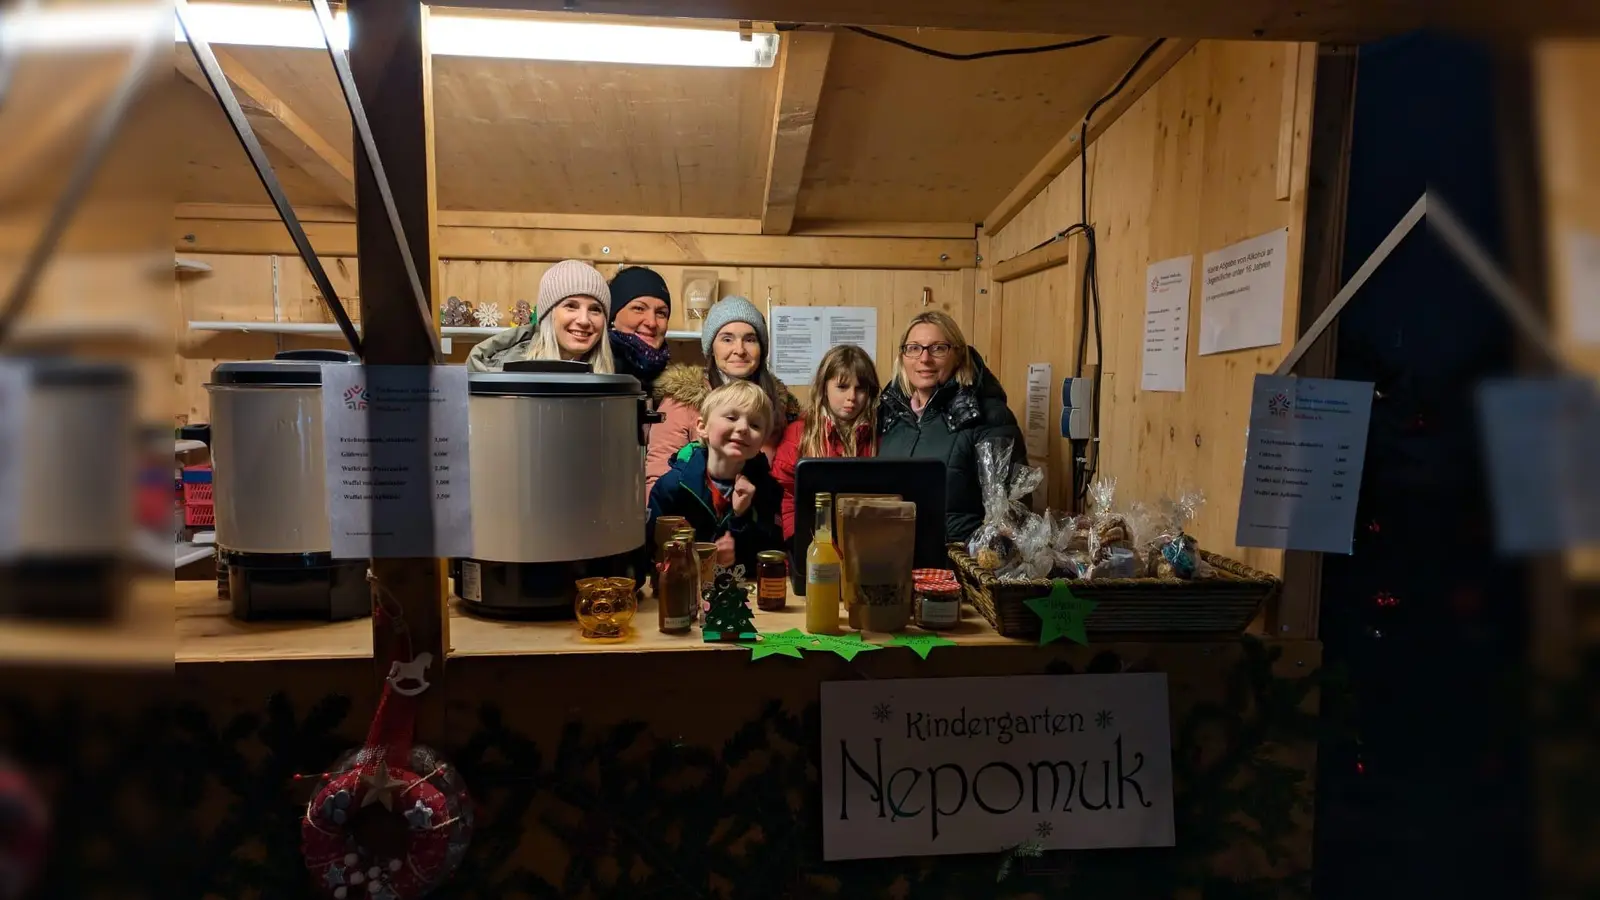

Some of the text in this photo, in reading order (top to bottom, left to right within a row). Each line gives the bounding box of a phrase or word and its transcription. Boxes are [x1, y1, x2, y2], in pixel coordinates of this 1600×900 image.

[1207, 272, 1231, 285] Jugendliche
[1252, 260, 1271, 271] Jahren
[1220, 259, 1237, 271] Abgabe
[1237, 256, 1246, 264] von
[1247, 250, 1266, 260] Alkohol
[906, 706, 1084, 744] Kindergarten
[839, 733, 1152, 840] Nepomuk
